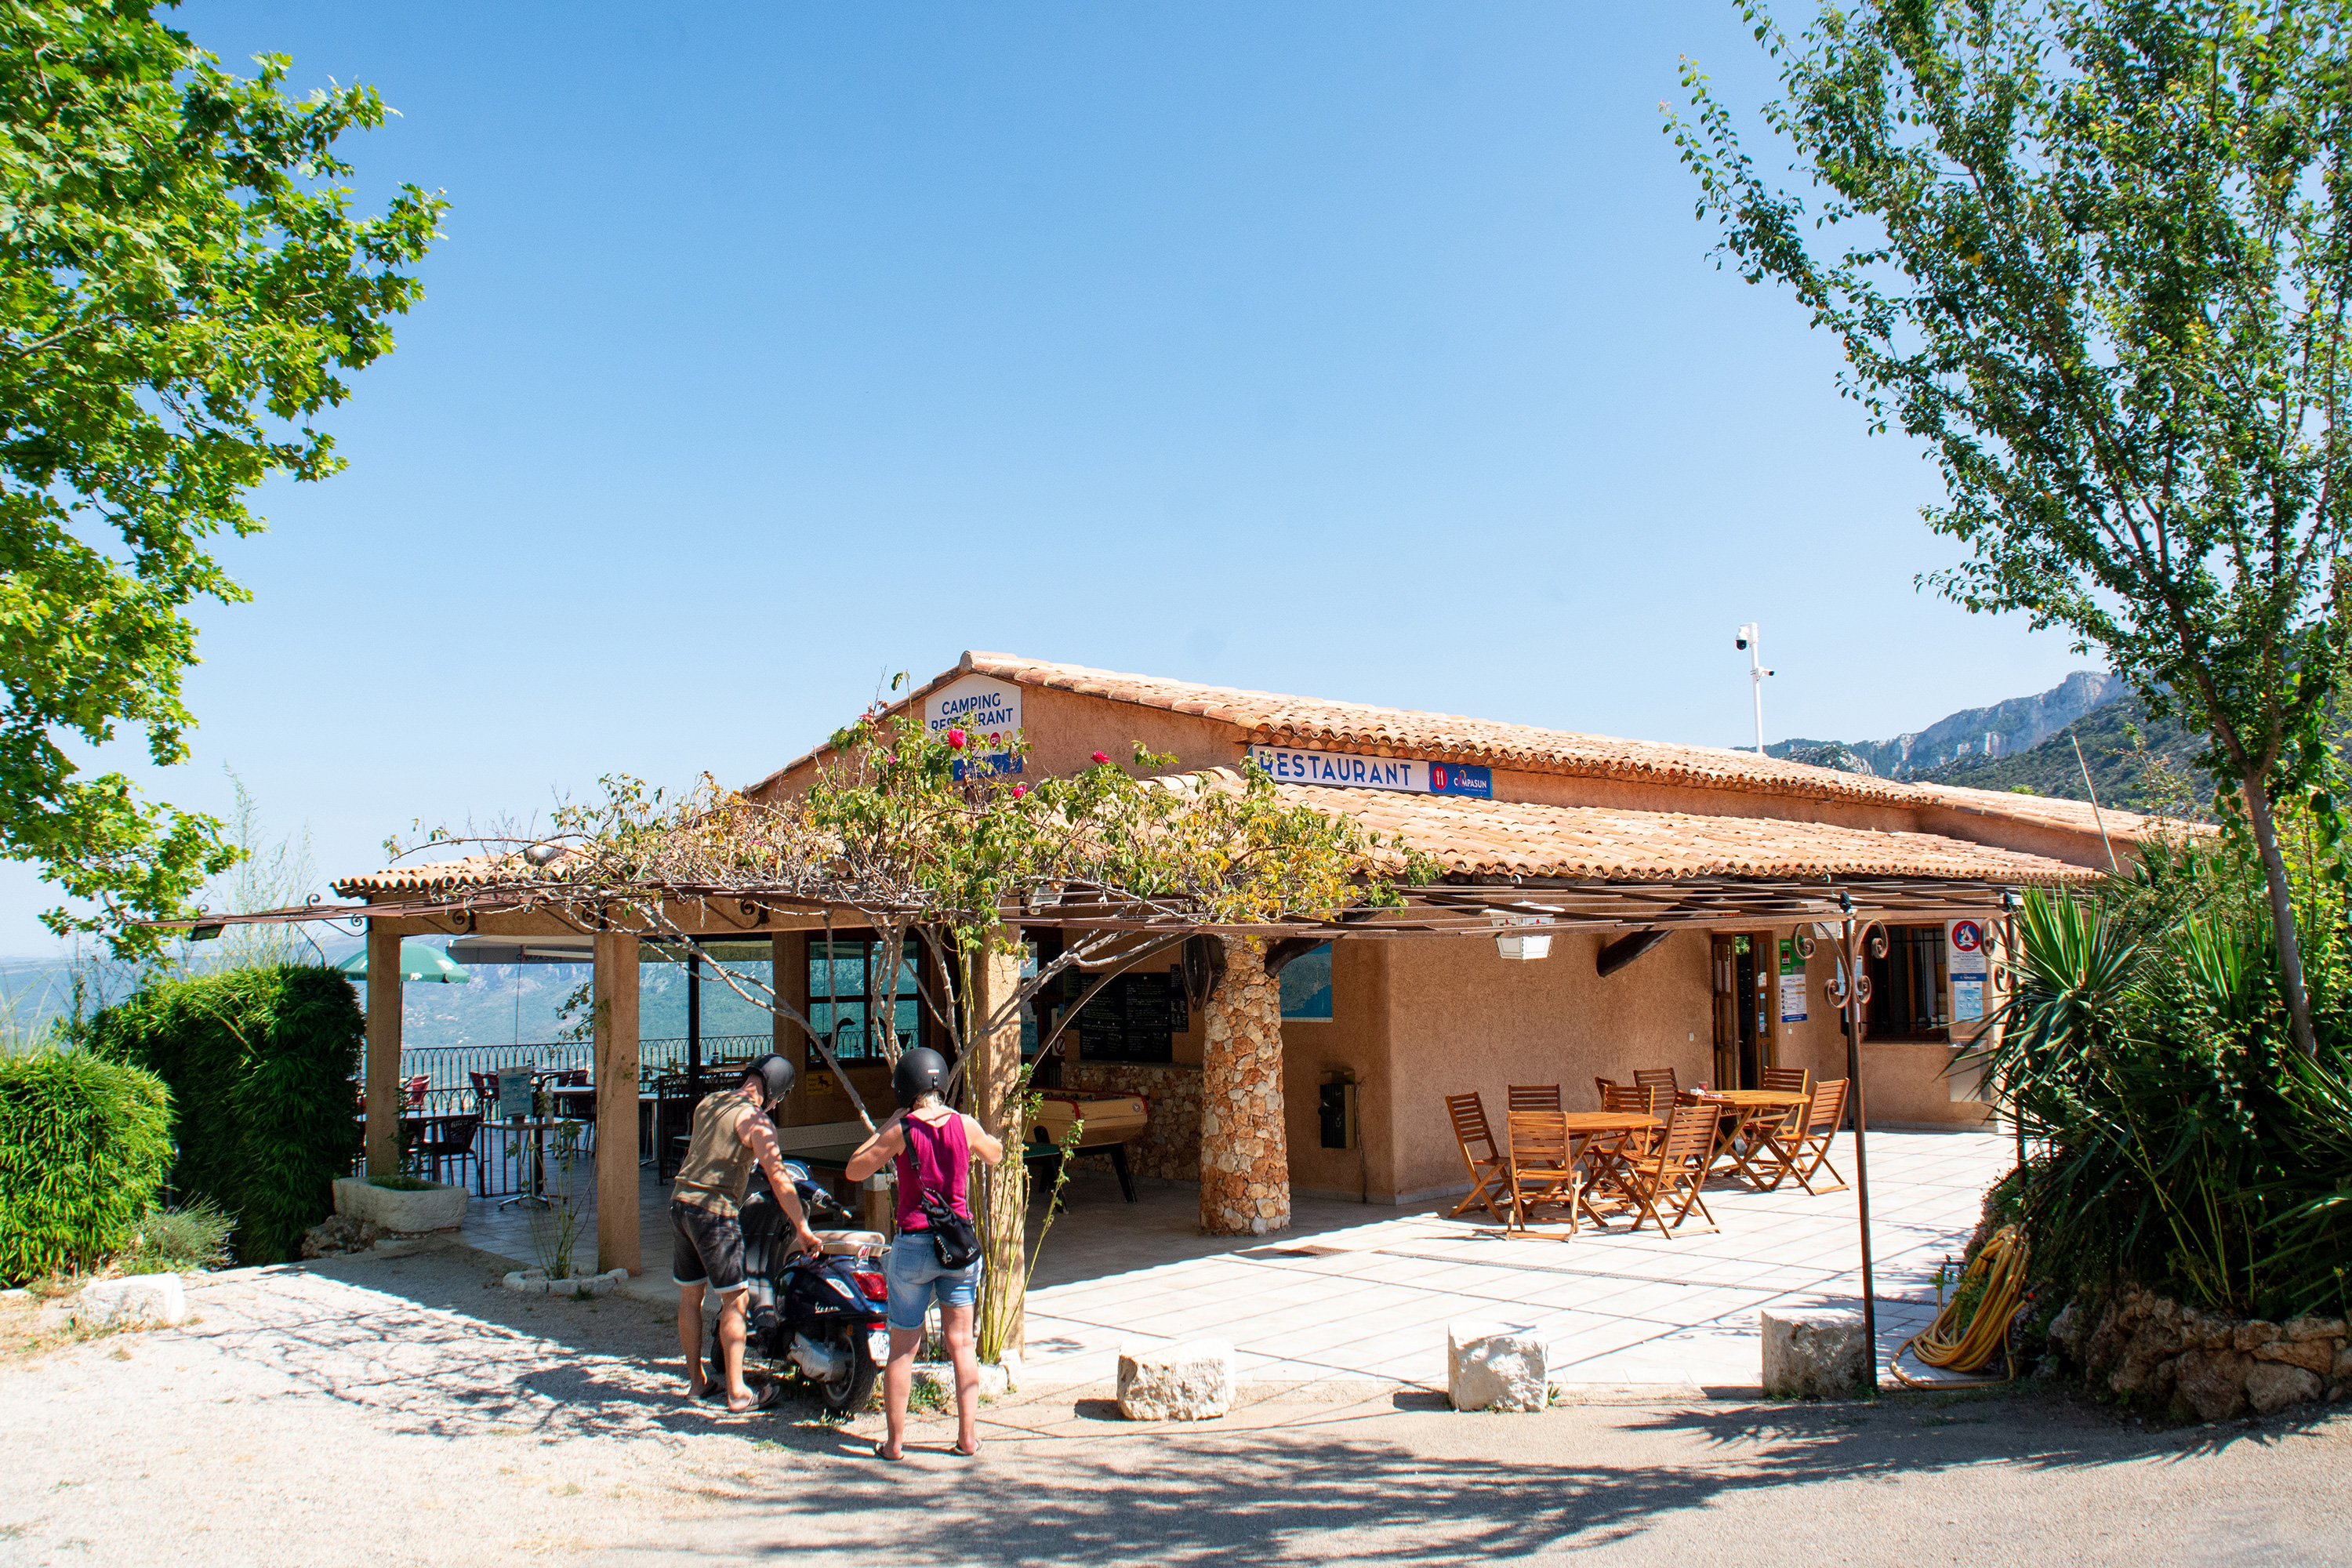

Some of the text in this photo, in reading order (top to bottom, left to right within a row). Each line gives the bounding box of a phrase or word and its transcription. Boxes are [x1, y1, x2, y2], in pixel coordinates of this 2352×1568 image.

[942, 692, 1000, 715] CAMPING
[931, 708, 1013, 731] RESTRANT
[1259, 750, 1411, 786] RESTAURANT
[1454, 773, 1487, 789] CAMPASUN
